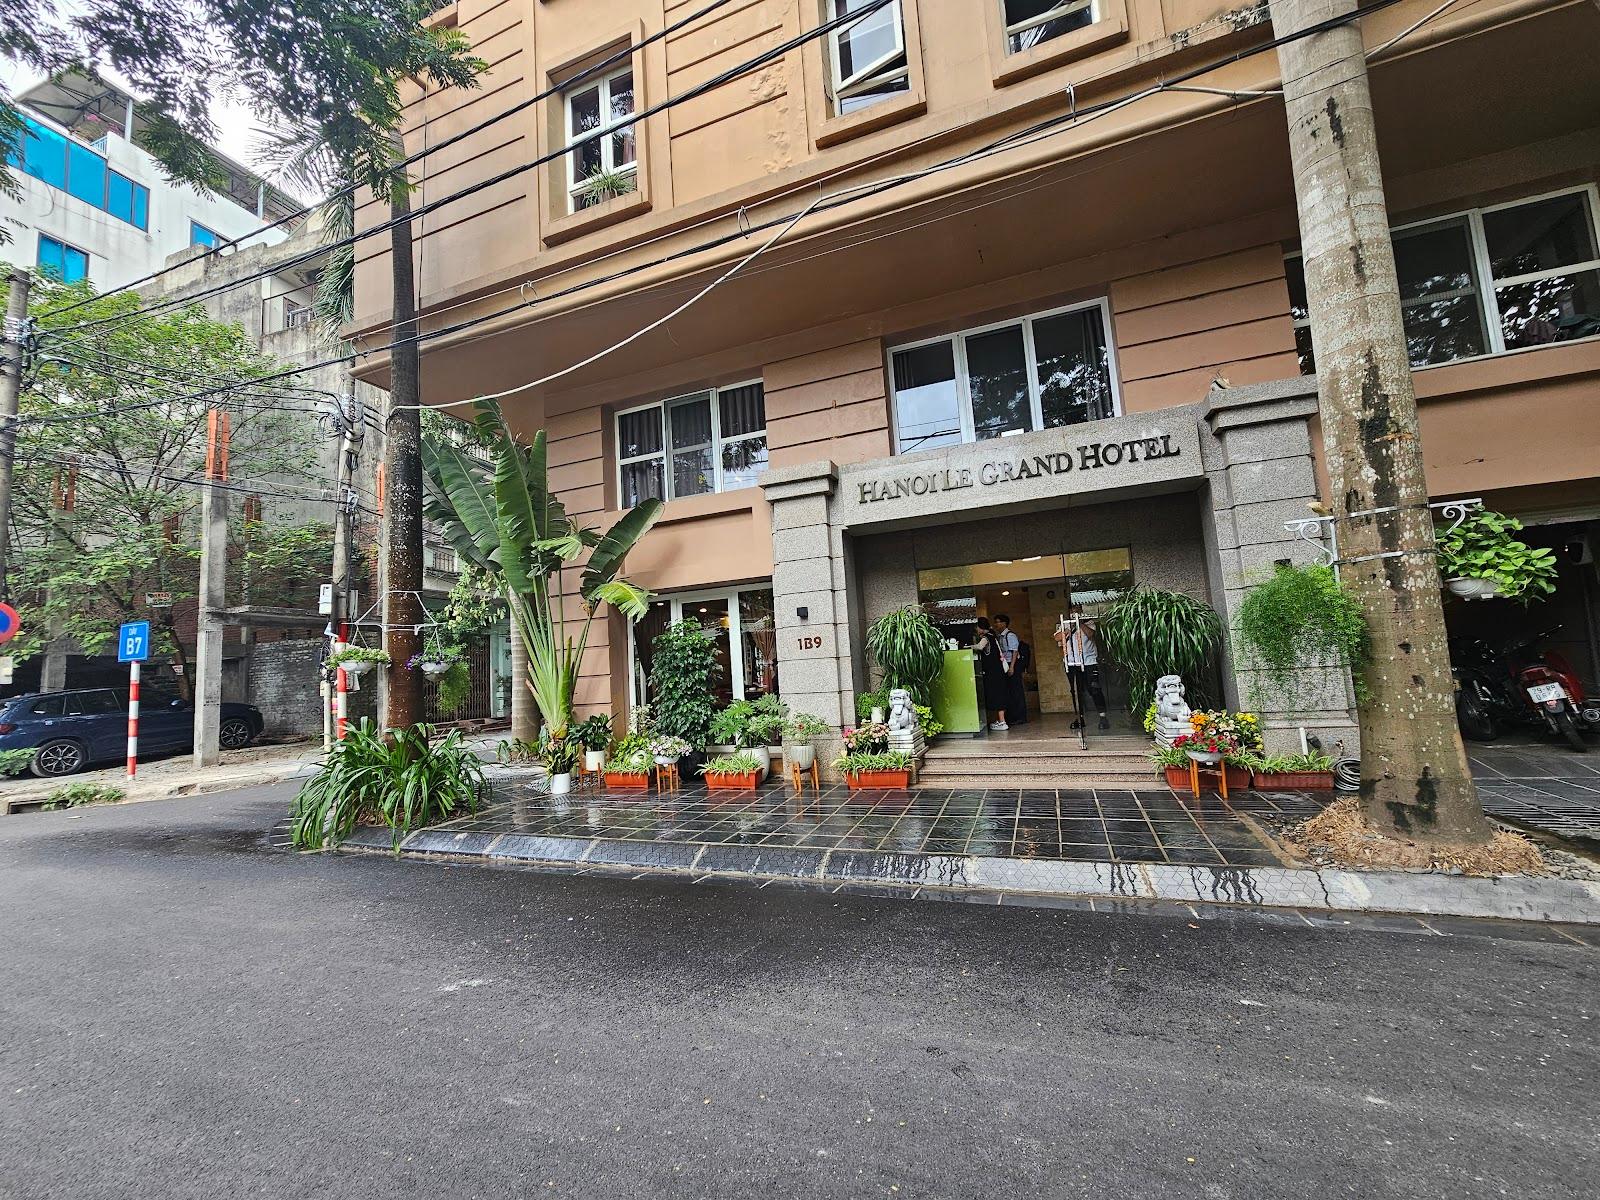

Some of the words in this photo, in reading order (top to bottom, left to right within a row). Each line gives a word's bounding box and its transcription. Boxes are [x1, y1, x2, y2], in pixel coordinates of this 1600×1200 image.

[857, 473, 938, 504] HANOI
[940, 468, 974, 492] LE
[978, 452, 1073, 486] GRAND
[1076, 434, 1181, 471] HOTEL
[126, 636, 143, 655] B7
[797, 636, 822, 650] 1B9
